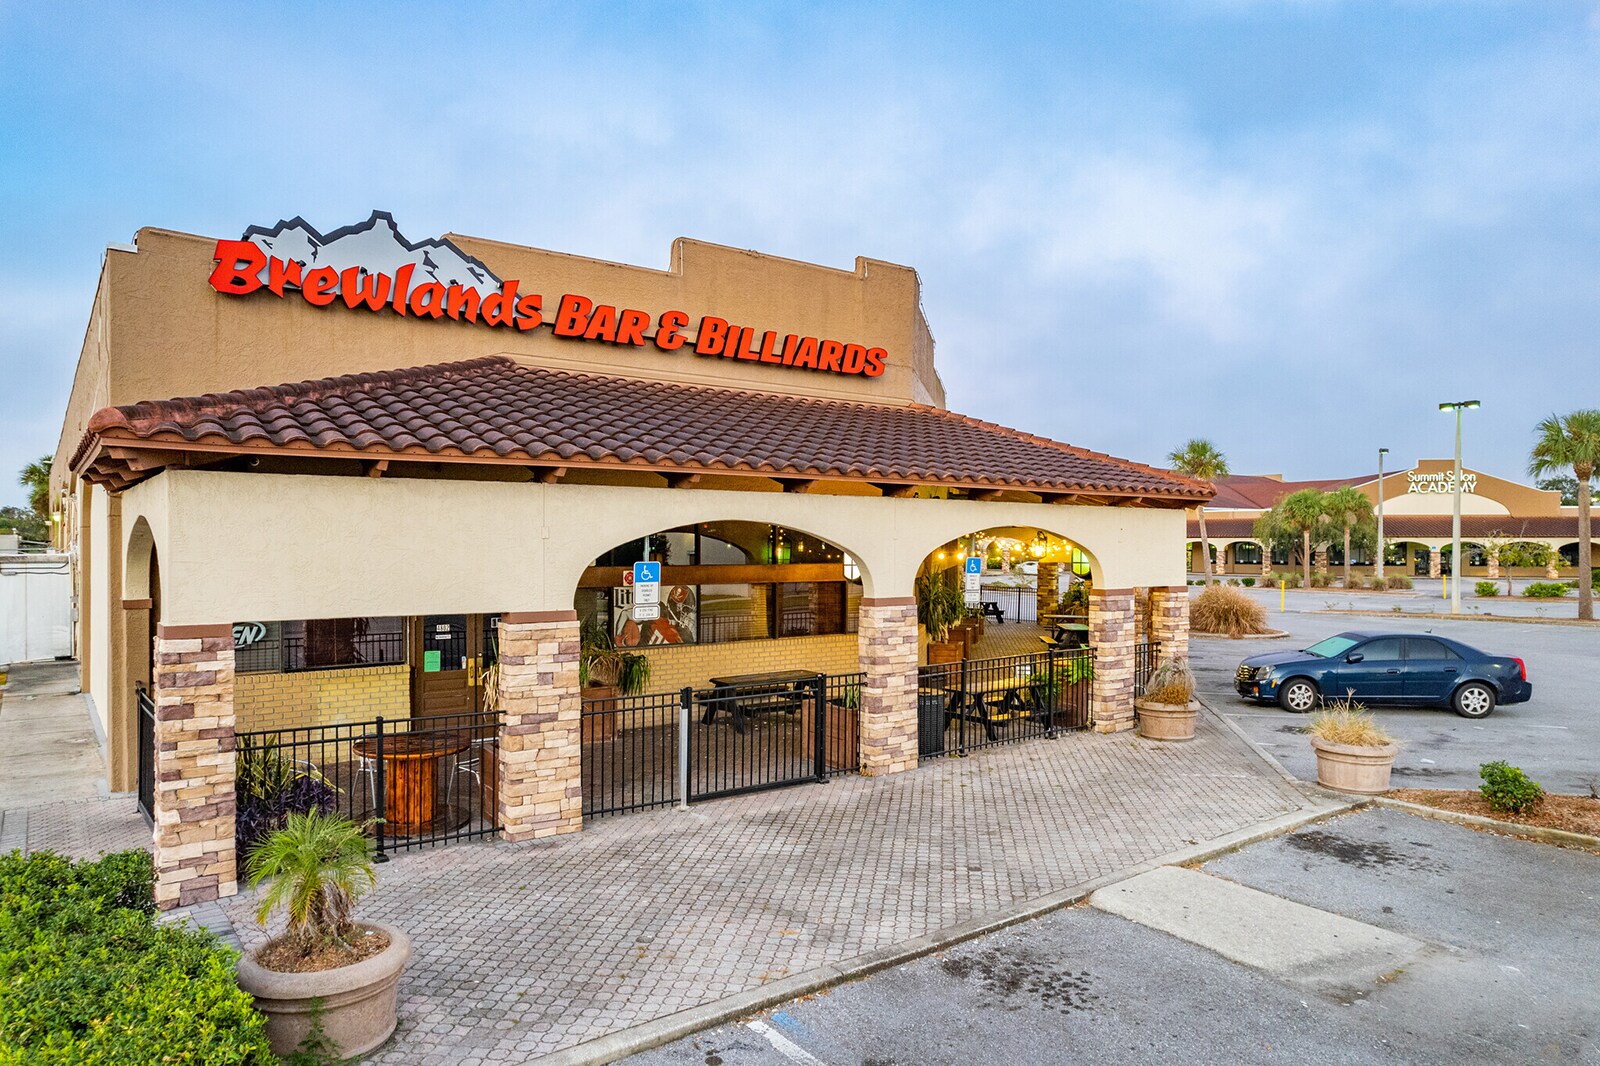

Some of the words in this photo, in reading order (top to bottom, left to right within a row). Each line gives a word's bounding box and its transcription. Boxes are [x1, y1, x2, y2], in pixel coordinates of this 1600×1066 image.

[208, 240, 542, 331] Brewlands
[553, 294, 650, 346] BAR
[655, 310, 689, 350] &
[695, 316, 888, 377] BILLIARDS
[1407, 471, 1444, 482] Summit
[1446, 470, 1476, 482] Slon
[1407, 481, 1477, 493] ACADEMY
[615, 589, 633, 609] Lit
[233, 626, 258, 645] EN
